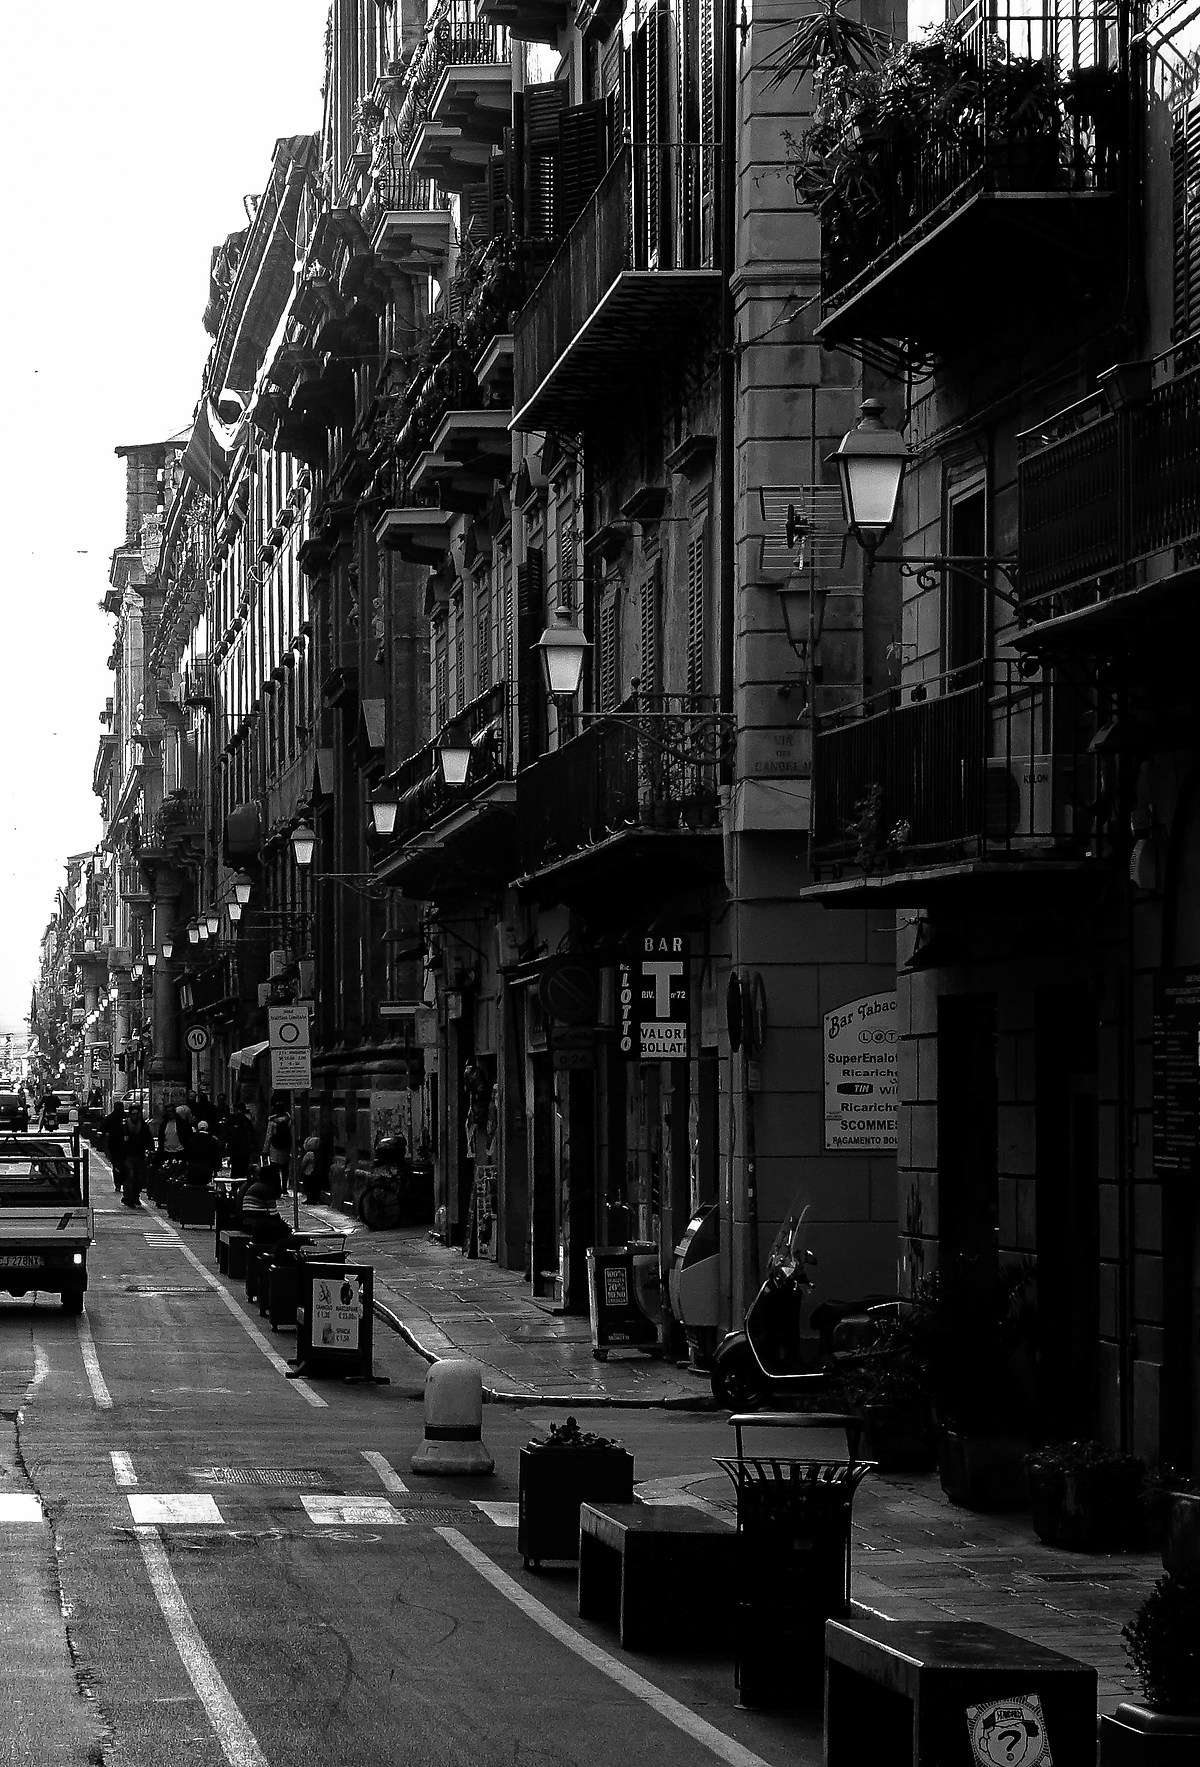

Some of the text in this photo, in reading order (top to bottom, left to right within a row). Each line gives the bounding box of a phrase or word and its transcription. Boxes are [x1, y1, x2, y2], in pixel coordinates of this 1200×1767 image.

[644, 937, 682, 952] BAR
[620, 973, 632, 1051] LOTTO
[829, 1001, 897, 1039] Bar Tabac
[641, 1029, 686, 1039] VALORI
[192, 1034, 204, 1045] 10
[641, 1043, 686, 1053] BOLLATI
[854, 1085, 870, 1093] TIM
[841, 1103, 899, 1112] Ricariche
[832, 1137, 881, 1145] PAGAMENTO
